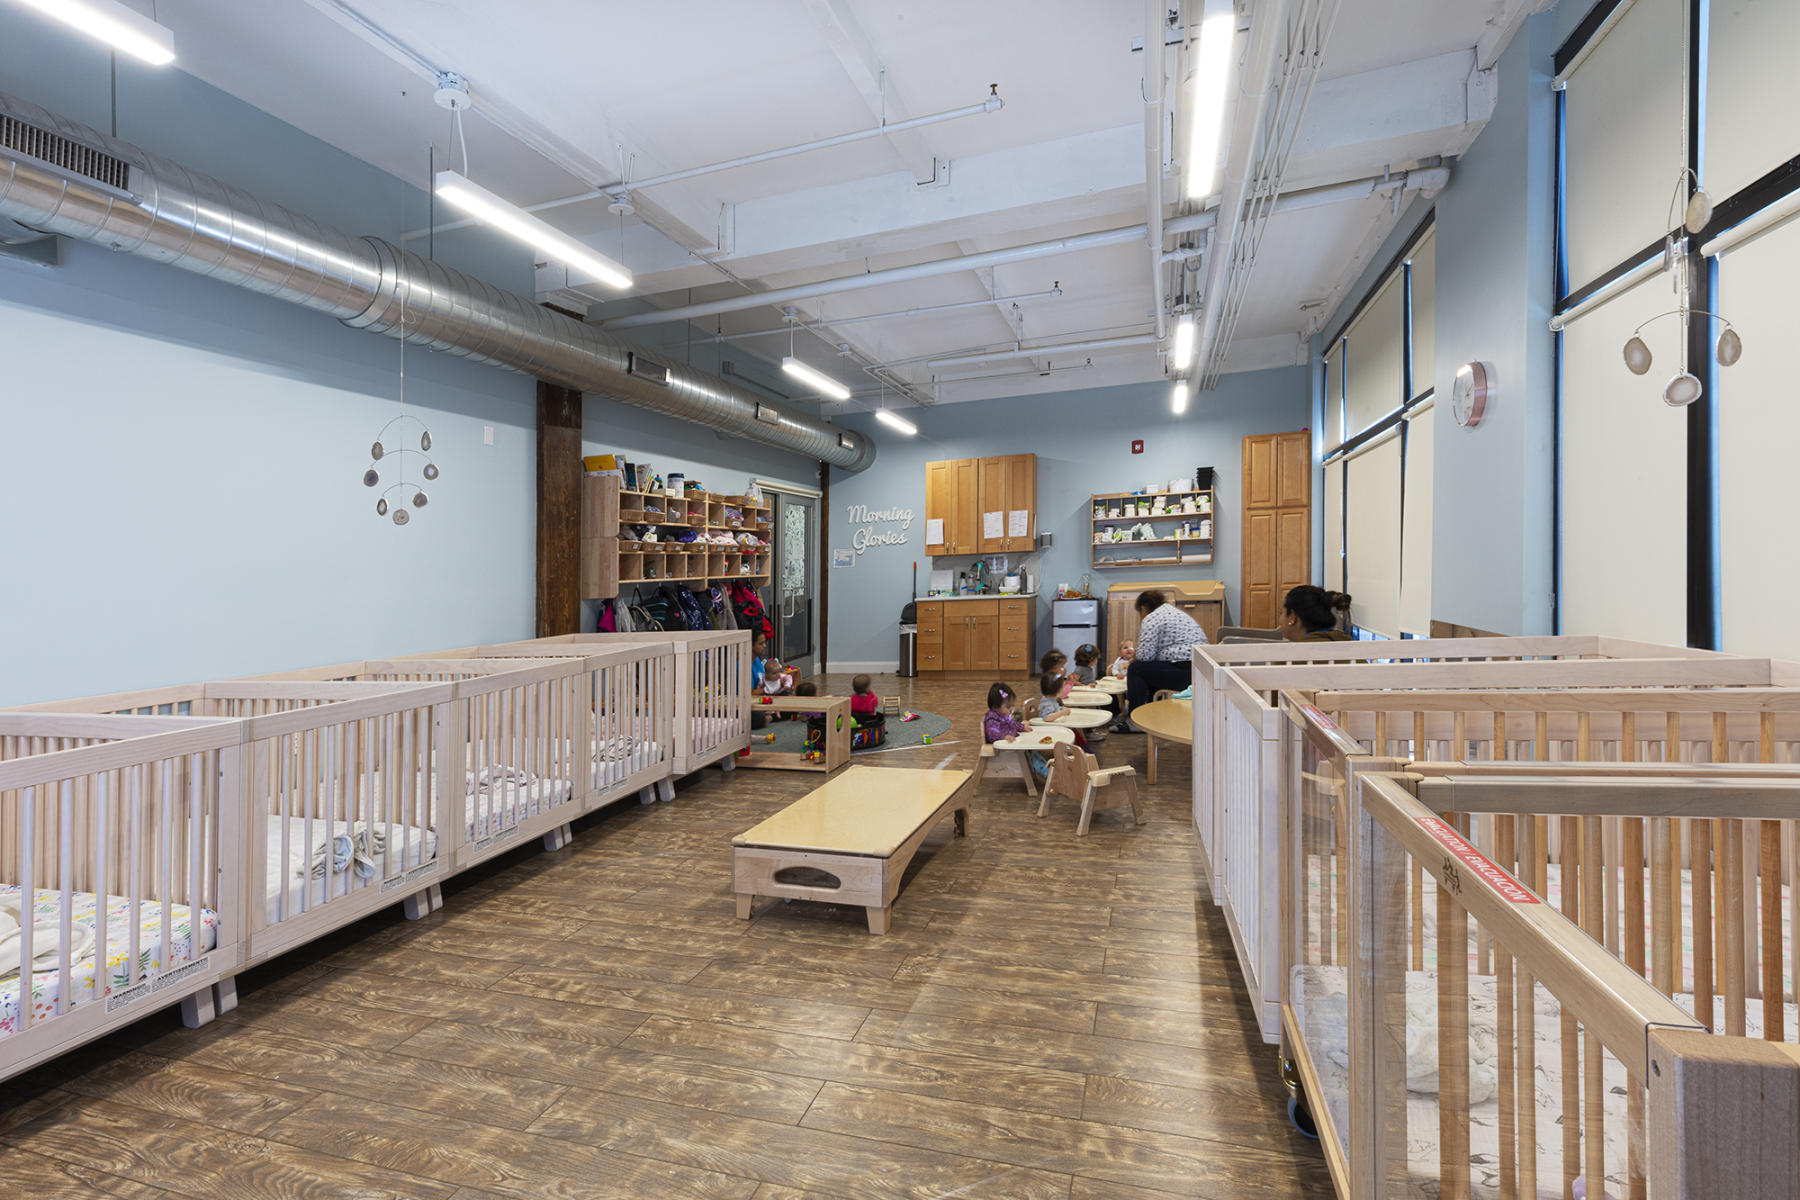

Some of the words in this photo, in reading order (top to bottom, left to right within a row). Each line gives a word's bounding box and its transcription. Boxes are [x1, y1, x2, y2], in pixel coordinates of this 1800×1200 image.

[847, 504, 914, 530] Morning
[853, 526, 907, 555] Glories
[1420, 818, 1471, 852] EVACUATION
